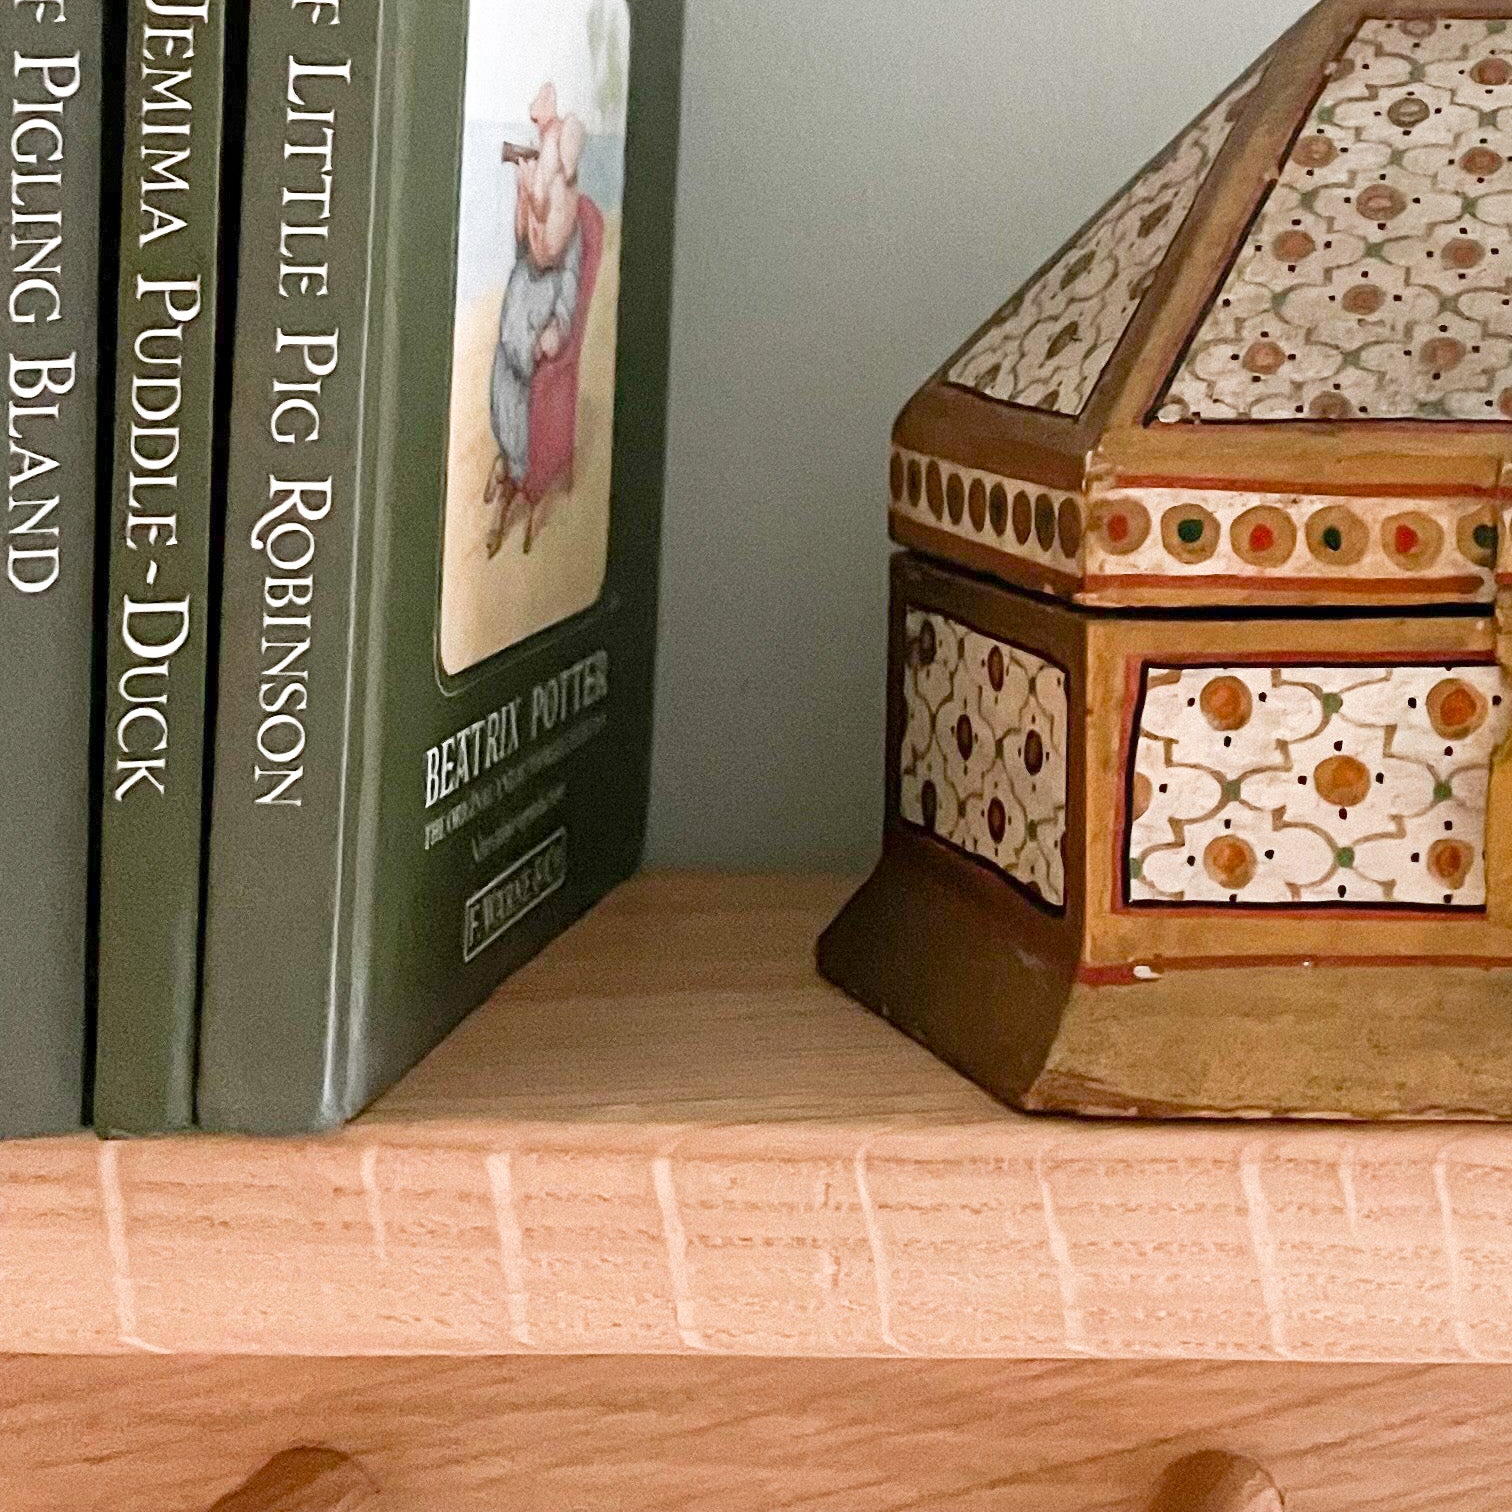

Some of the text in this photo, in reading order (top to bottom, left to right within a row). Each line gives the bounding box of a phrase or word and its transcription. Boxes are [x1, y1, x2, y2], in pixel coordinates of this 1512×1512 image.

[9, 51, 80, 322] PIGLING
[279, 56, 351, 297] LITTLE
[8, 352, 76, 592] BLAND
[271, 328, 338, 443] PIG
[251, 475, 332, 806] ROBINSON
[425, 697, 522, 809] BEATRIX
